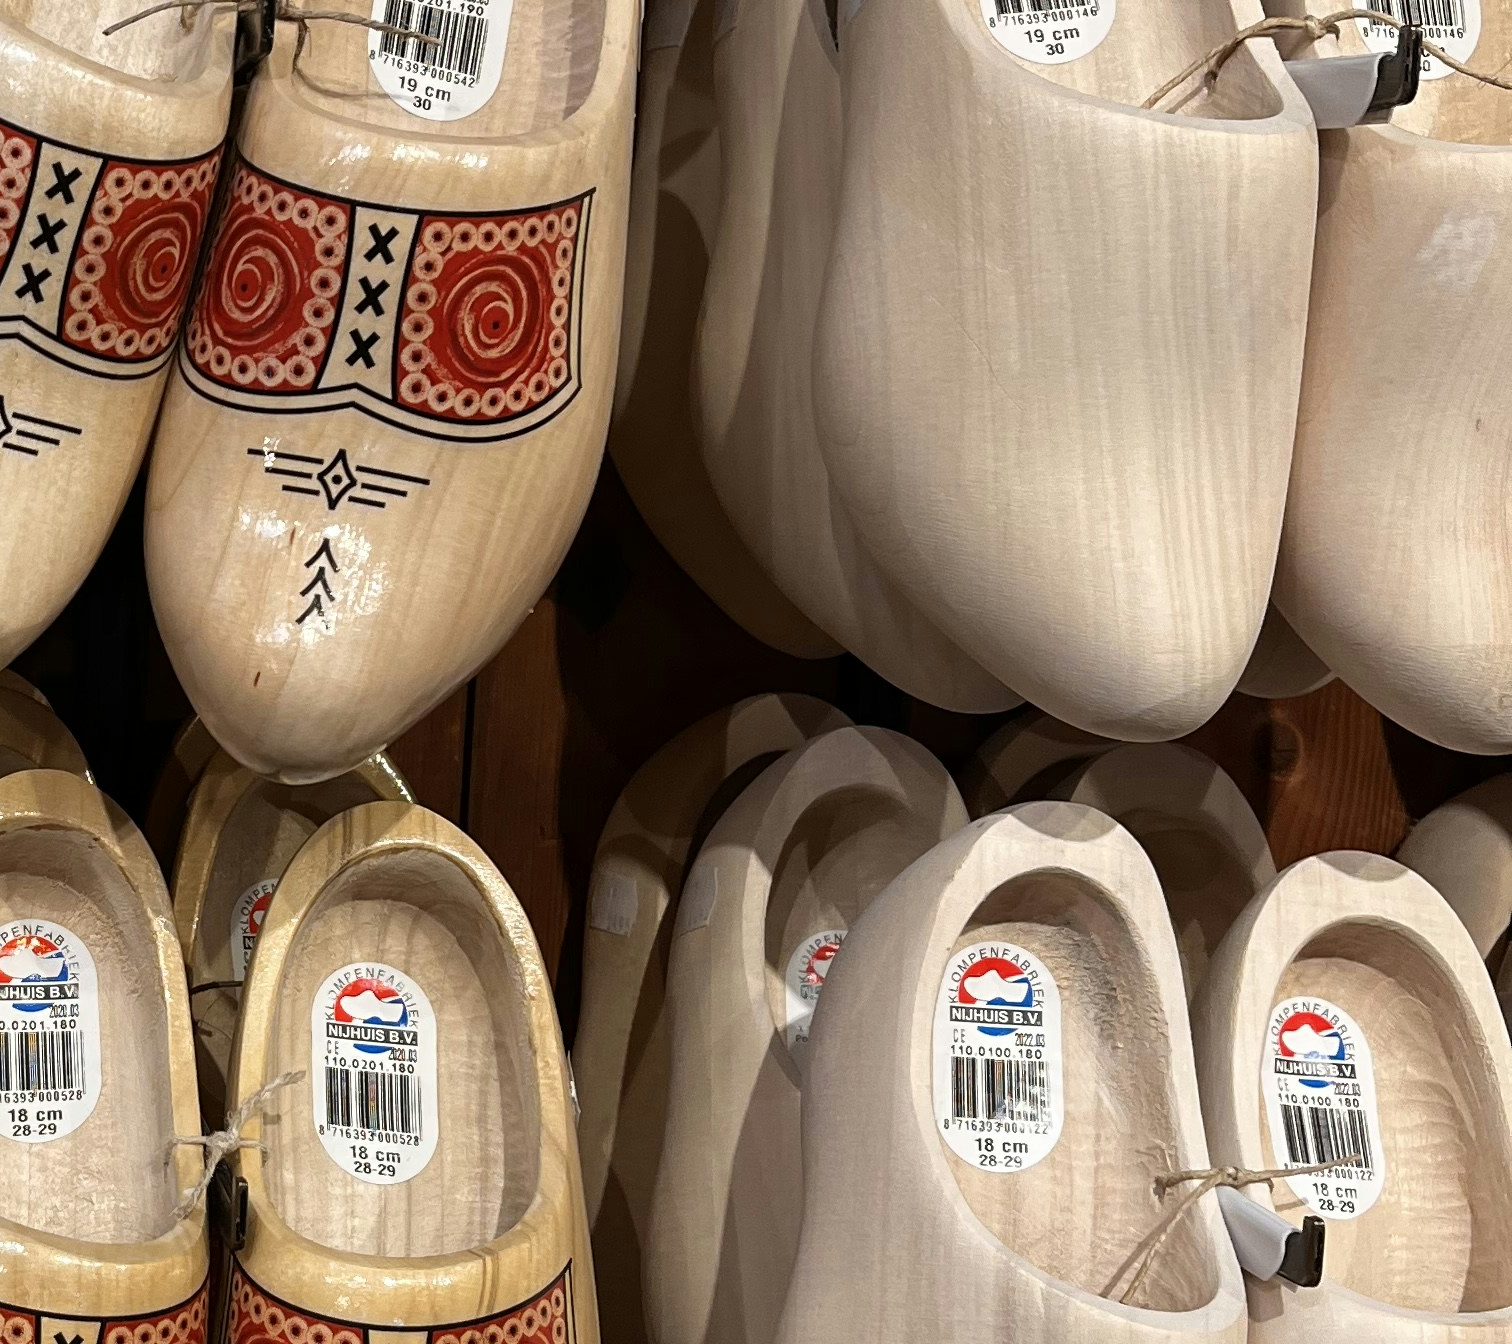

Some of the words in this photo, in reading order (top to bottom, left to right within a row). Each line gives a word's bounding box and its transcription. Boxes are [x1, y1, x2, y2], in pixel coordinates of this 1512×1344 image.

[1024, 29, 1044, 44] 19
[1052, 27, 1080, 41] cm
[1046, 43, 1064, 56] 30
[399, 76, 418, 93] 19
[426, 86, 451, 102] cm
[413, 95, 431, 111] 30
[949, 947, 1044, 1007] KLOMPENFABRIEK
[952, 1009, 1008, 1023] NIJHUIS
[1014, 1011, 1040, 1025] B.V.
[328, 1024, 384, 1041] NIJHUIS
[390, 1031, 417, 1046] B.V.
[950, 1044, 1042, 1059] 110.0100.180
[325, 1055, 414, 1074] 110.0201.180
[1278, 1093, 1359, 1107] 110.0100.180
[8, 1109, 28, 1122] 18
[37, 1109, 62, 1122] cm
[12, 1124, 57, 1136] 28-29
[975, 1137, 994, 1151] 18
[1002, 1141, 1028, 1153] cm
[350, 1146, 366, 1159] 18
[375, 1150, 400, 1163] cm
[979, 1154, 1022, 1167] 28-29
[354, 1161, 395, 1177] 28-29
[1312, 1183, 1327, 1196] 18
[1336, 1187, 1357, 1198] cm
[1319, 1198, 1354, 1212] 28-29
